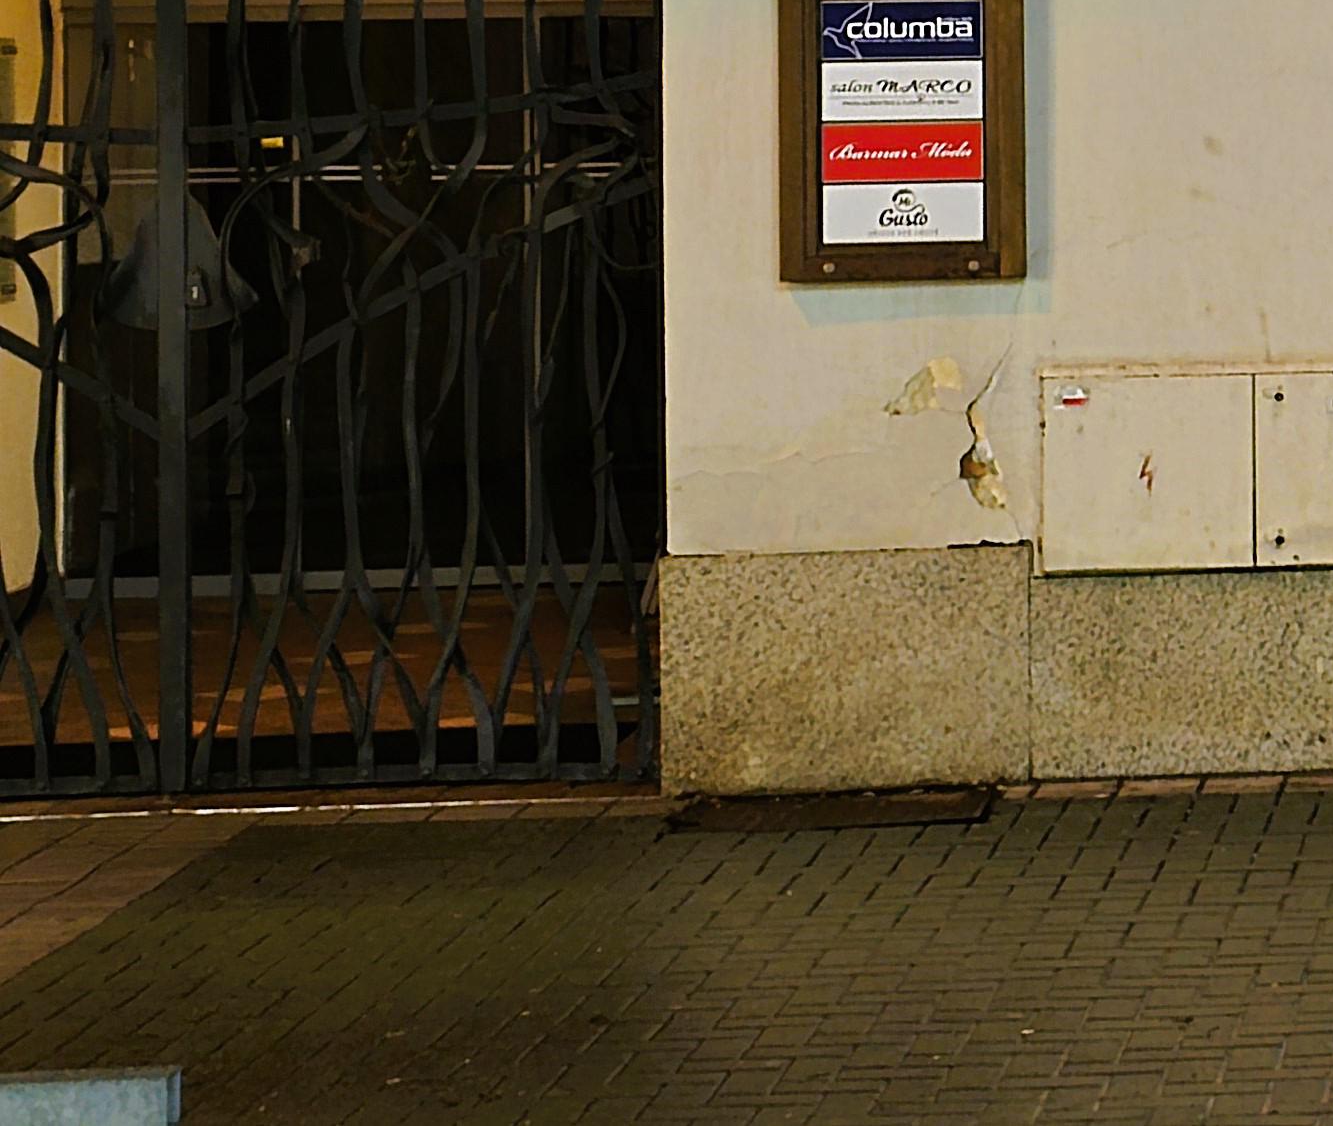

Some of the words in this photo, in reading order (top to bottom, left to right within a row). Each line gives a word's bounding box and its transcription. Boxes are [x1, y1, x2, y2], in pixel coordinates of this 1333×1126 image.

[846, 16, 973, 39] columba
[829, 79, 874, 93] salon
[875, 79, 972, 94] MARCO
[878, 208, 928, 227] Gusto
